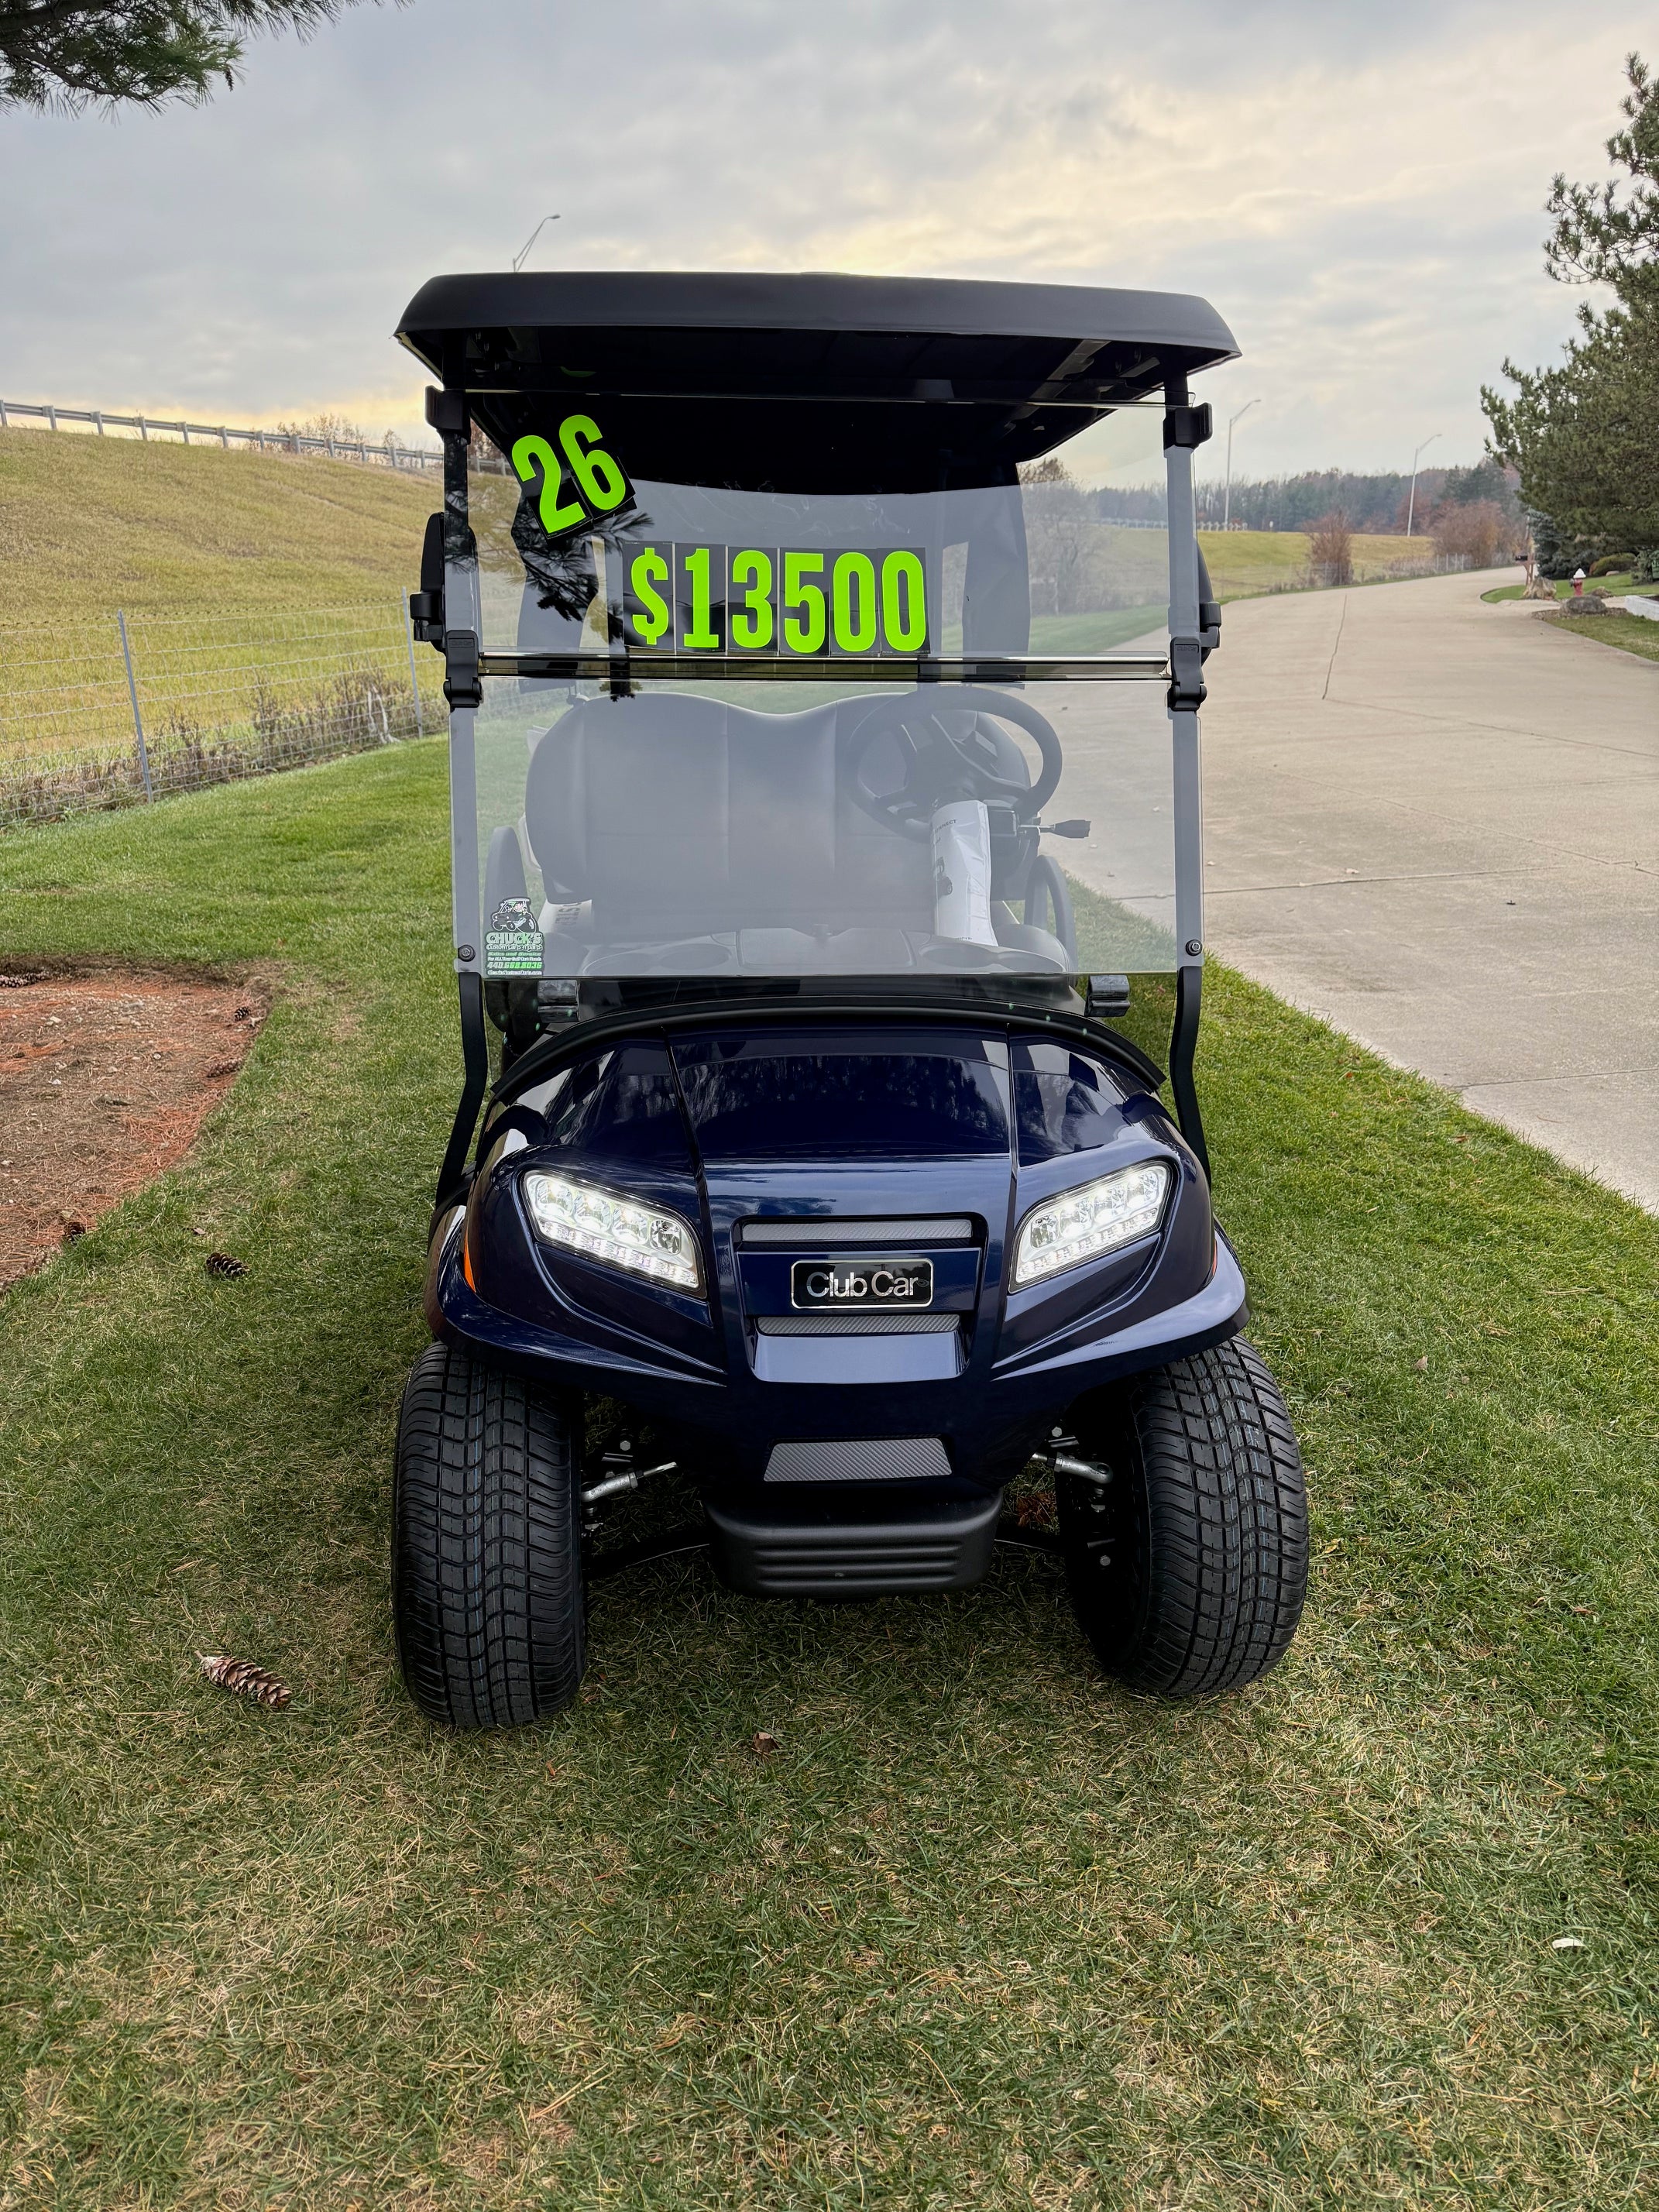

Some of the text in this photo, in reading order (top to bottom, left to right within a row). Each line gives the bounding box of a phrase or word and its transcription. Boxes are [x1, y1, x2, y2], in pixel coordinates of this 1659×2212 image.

[511, 414, 626, 534] 26
[630, 547, 926, 653] $13500
[486, 932, 542, 944] CHUCK'S
[806, 1270, 919, 1297] Club Car
